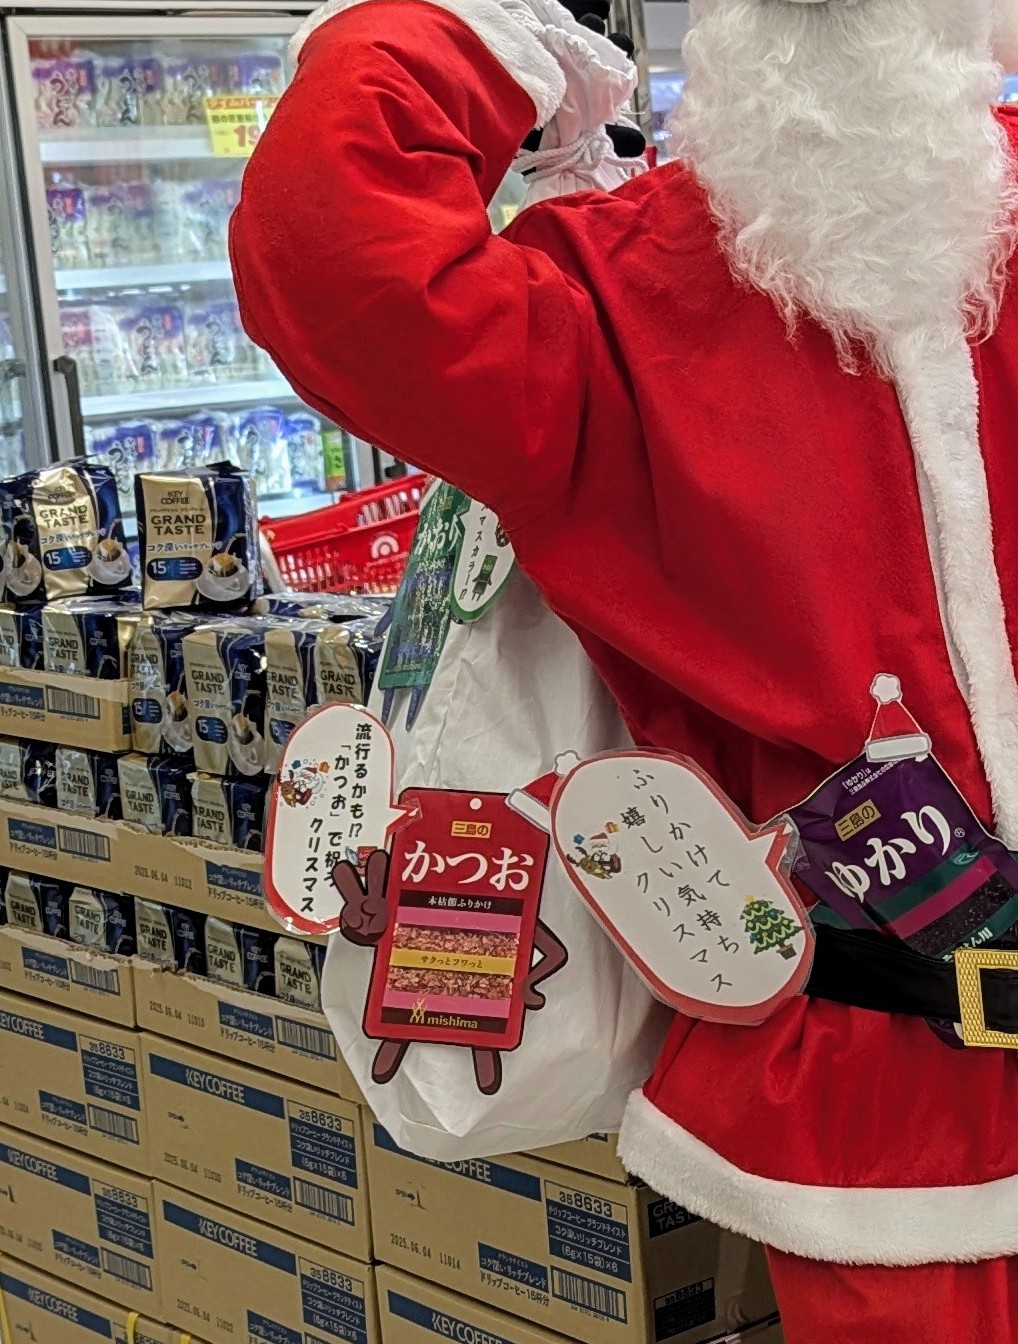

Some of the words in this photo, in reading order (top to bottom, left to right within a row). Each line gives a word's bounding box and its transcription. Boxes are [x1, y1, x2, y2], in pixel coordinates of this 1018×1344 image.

[39, 505, 88, 520] GRAND
[44, 514, 89, 529] TASTE
[150, 514, 206, 525] GRAND
[154, 524, 205, 536] TASTE
[151, 560, 167, 575] 15
[48, 637, 79, 650] GRAND
[49, 648, 78, 661] TASTE
[191, 669, 225, 684] GRAND
[320, 669, 355, 685] GRAND
[193, 681, 225, 696] TASTE
[321, 681, 355, 697] TASTE
[125, 789, 155, 803] GRAND
[128, 800, 154, 815] TASTE
[453, 823, 490, 837] 三島の
[632, 768, 730, 888] ふりかけて
[838, 805, 876, 838] 三島の
[825, 805, 951, 904] ゆかり
[300, 816, 324, 913] クリスマス
[401, 839, 535, 892] かつお
[620, 806, 740, 954] 嬉しい気持ち
[139, 923, 168, 941] GRAND
[636, 871, 733, 993] クリスマス
[142, 934, 167, 952] TASTE
[207, 943, 236, 961] GRAND
[209, 957, 236, 974] TASTE
[279, 962, 312, 983] GRAND
[281, 974, 312, 995] TASTE
[427, 1014, 479, 1030] mishima
[185, 1068, 206, 1090] KEY
[206, 1077, 246, 1104] COFFEE
[559, 1190, 613, 1218] 358633
[198, 1218, 217, 1240] KEY
[218, 1227, 258, 1257] COFFEE
[310, 1267, 353, 1292] 358633
[431, 1312, 457, 1337] KEY
